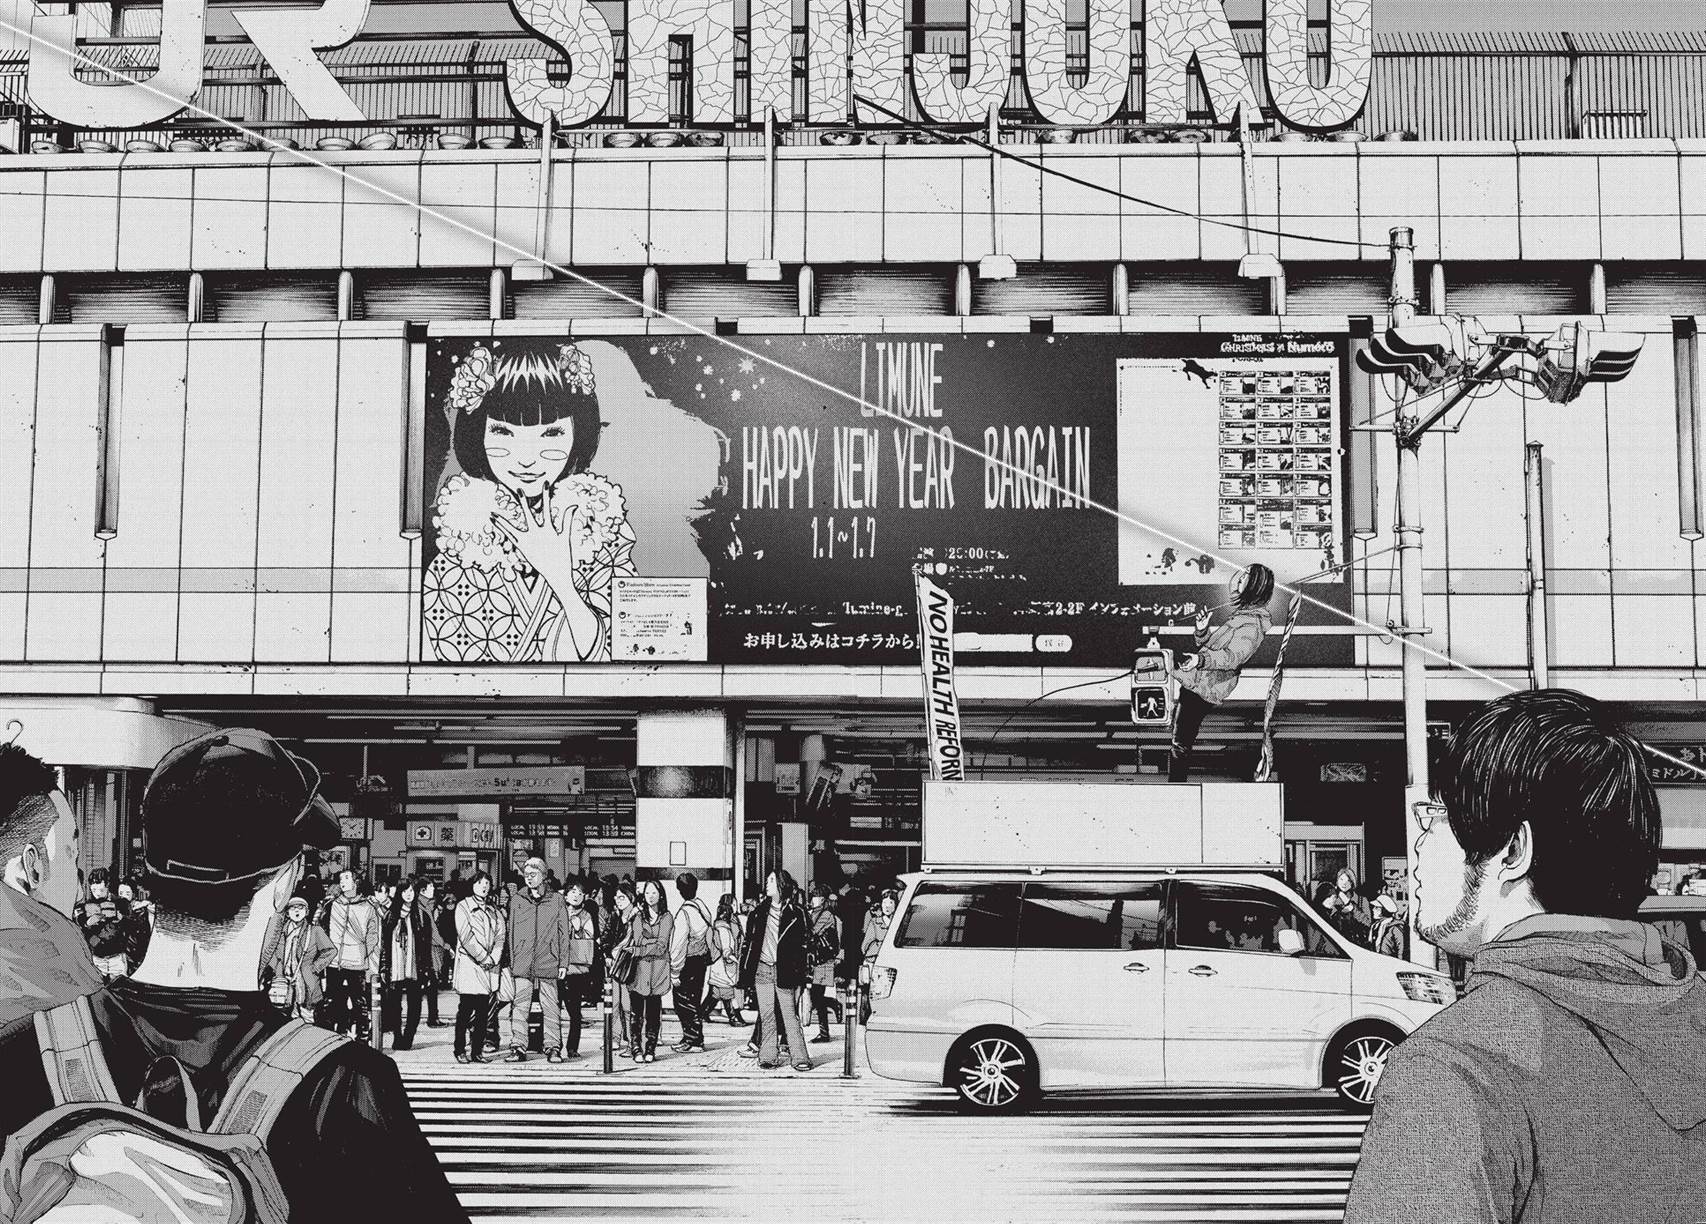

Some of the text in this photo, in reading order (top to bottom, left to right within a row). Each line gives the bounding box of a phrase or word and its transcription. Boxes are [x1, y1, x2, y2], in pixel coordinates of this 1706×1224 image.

[861, 342, 944, 418] LIMUNE
[742, 424, 1091, 510] HAPPY NEW YEAR BARGAIN
[928, 590, 949, 634] NO
[929, 634, 956, 717] HEALTH
